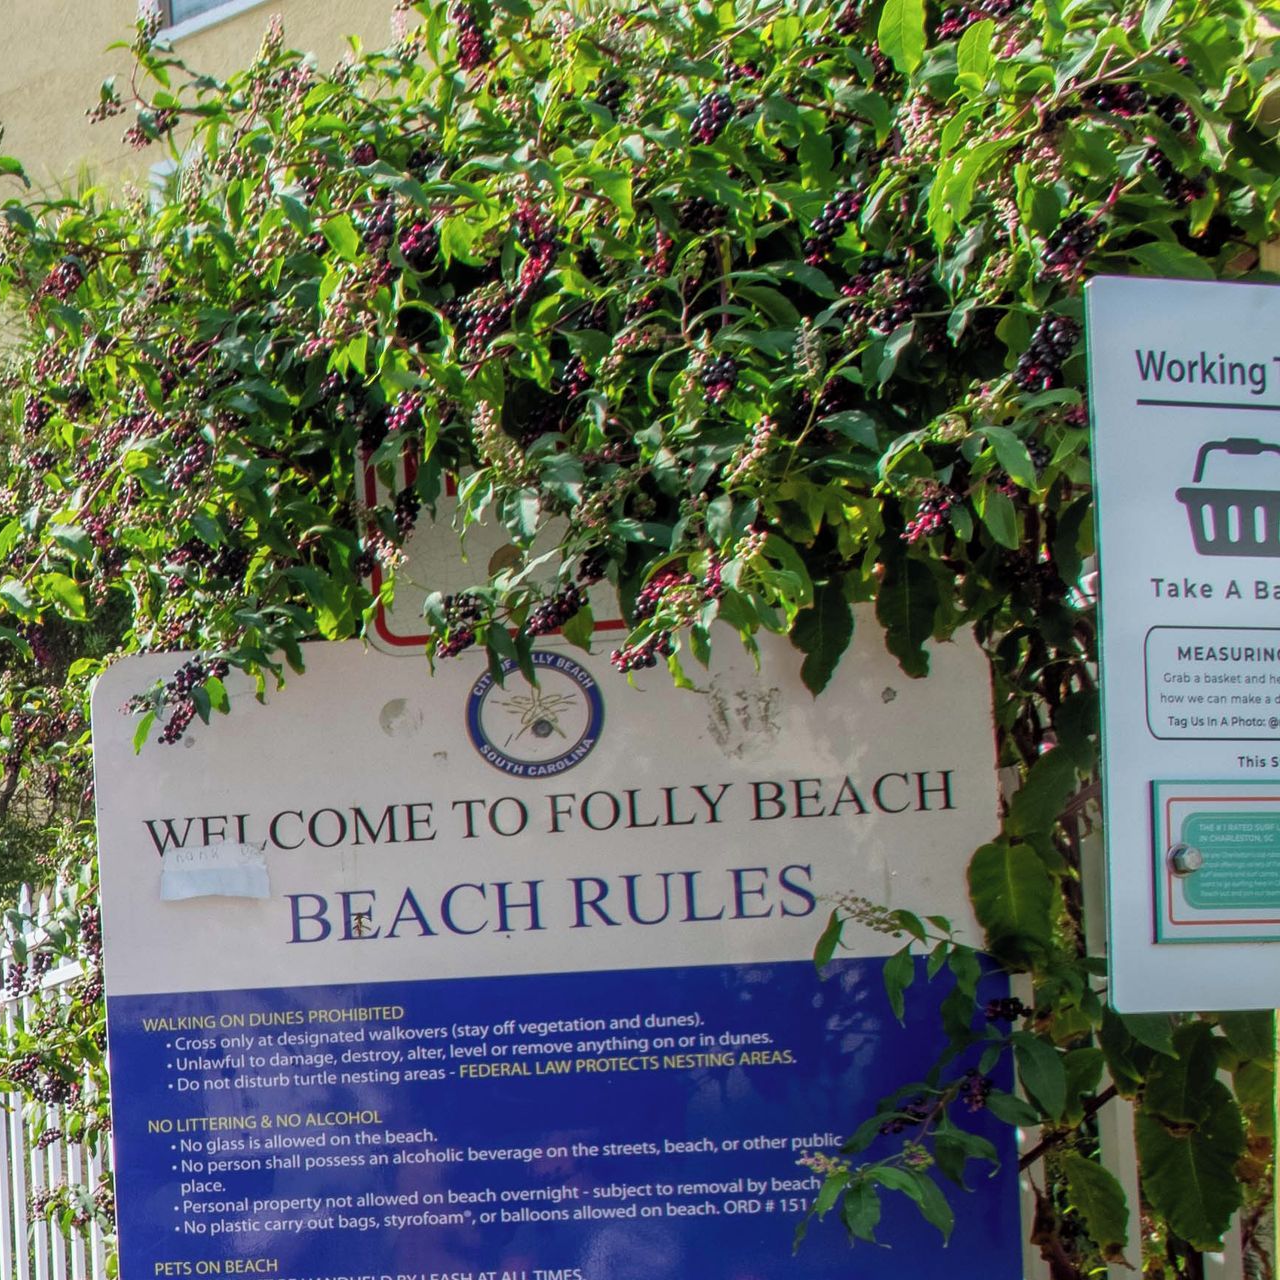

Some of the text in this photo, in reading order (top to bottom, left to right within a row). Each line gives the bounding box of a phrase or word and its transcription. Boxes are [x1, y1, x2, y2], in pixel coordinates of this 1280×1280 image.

[1135, 348, 1267, 395] Working
[1150, 577, 1213, 599] Take
[1225, 579, 1242, 599] A
[473, 672, 492, 697] CIT
[556, 656, 594, 689] BEACH
[1163, 672, 1190, 683] Grab
[1194, 674, 1201, 683] a
[1204, 673, 1241, 684] basket
[1244, 674, 1266, 684] and
[1160, 692, 1184, 704] how
[1187, 695, 1204, 703] we
[1206, 695, 1227, 704] can
[1231, 693, 1262, 704] make
[1264, 695, 1271, 704] a
[1167, 715, 1188, 729] Tag
[1190, 716, 1204, 726] Us
[1207, 716, 1217, 726] In
[1220, 717, 1228, 727] A
[480, 739, 594, 776] SOUTH CAROLINA
[1237, 755, 1266, 768] This
[451, 796, 528, 839] TO
[544, 783, 733, 833] FOLLY
[747, 769, 956, 821] BEACH
[284, 863, 821, 944] BEACH RULES
[141, 1005, 404, 1032] WALKING ON DUNES PROHIBITED
[174, 1011, 704, 1052] Cross only at designated walkovers (stay off vegetation and dunes).
[148, 1109, 383, 1133] NO LITTERING & NO ALCOHOL
[180, 1128, 437, 1155] No glass is allowed on the beach.
[154, 1258, 278, 1276] PETS ON BEACH
